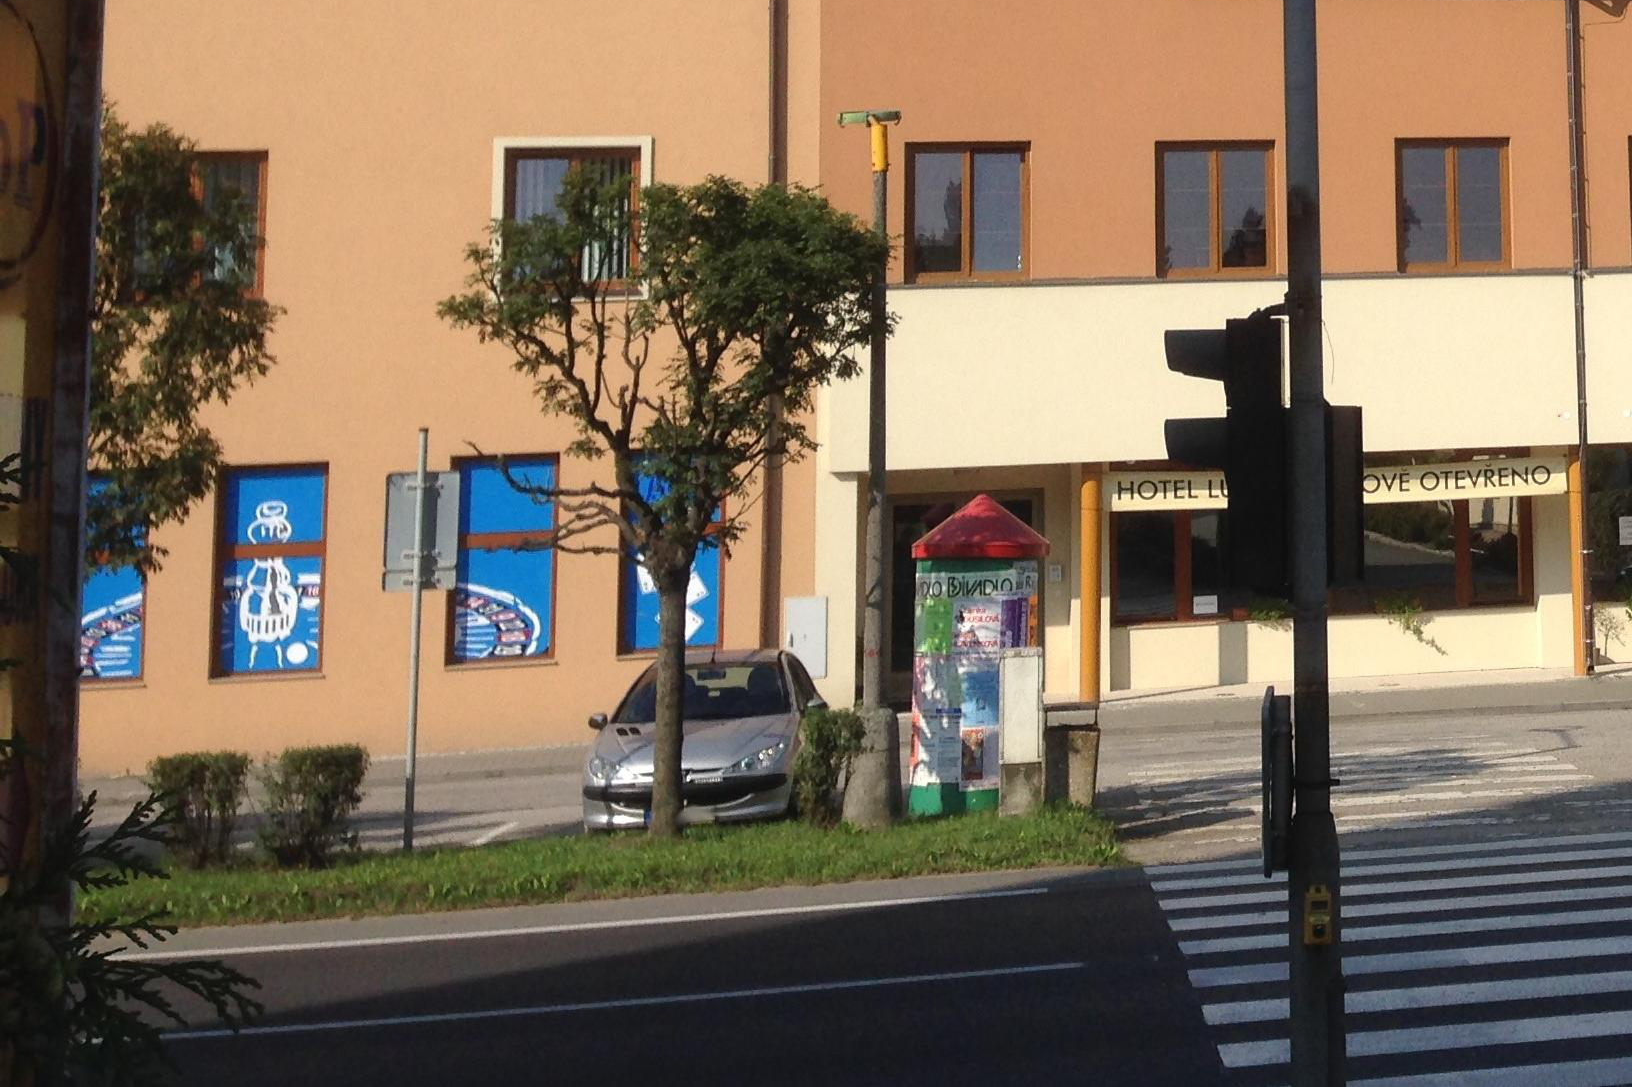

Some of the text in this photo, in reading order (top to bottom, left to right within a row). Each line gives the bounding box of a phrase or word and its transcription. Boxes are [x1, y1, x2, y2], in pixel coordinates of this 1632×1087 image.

[1117, 464, 1551, 500] HOTEL LU OVĚ OTEVŘENO
